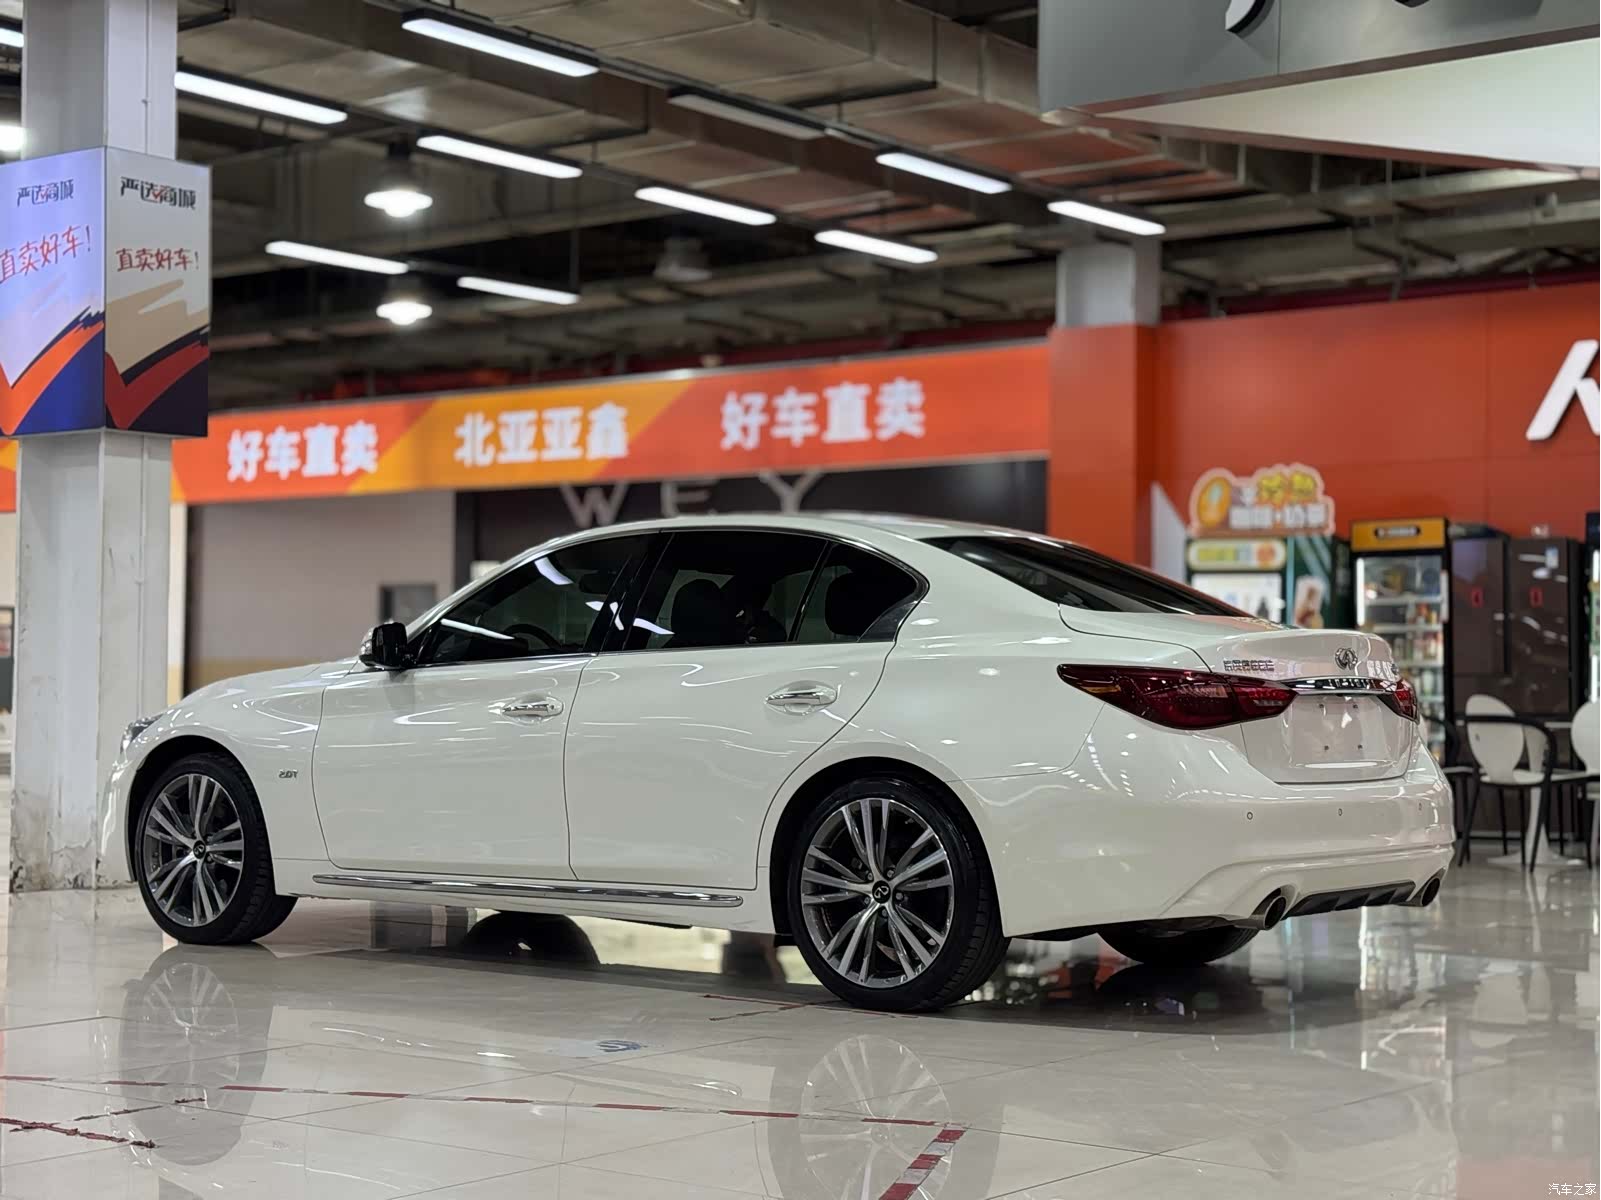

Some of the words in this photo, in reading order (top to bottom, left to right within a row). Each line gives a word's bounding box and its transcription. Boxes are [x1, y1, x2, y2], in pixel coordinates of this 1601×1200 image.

[16, 178, 75, 207] 严选商城
[120, 176, 197, 210] 严选商城
[454, 401, 631, 468] 北亚亚鑫
[721, 375, 926, 451] 好车直卖
[226, 420, 380, 483] 好车直卖
[559, 467, 824, 528] WEY
